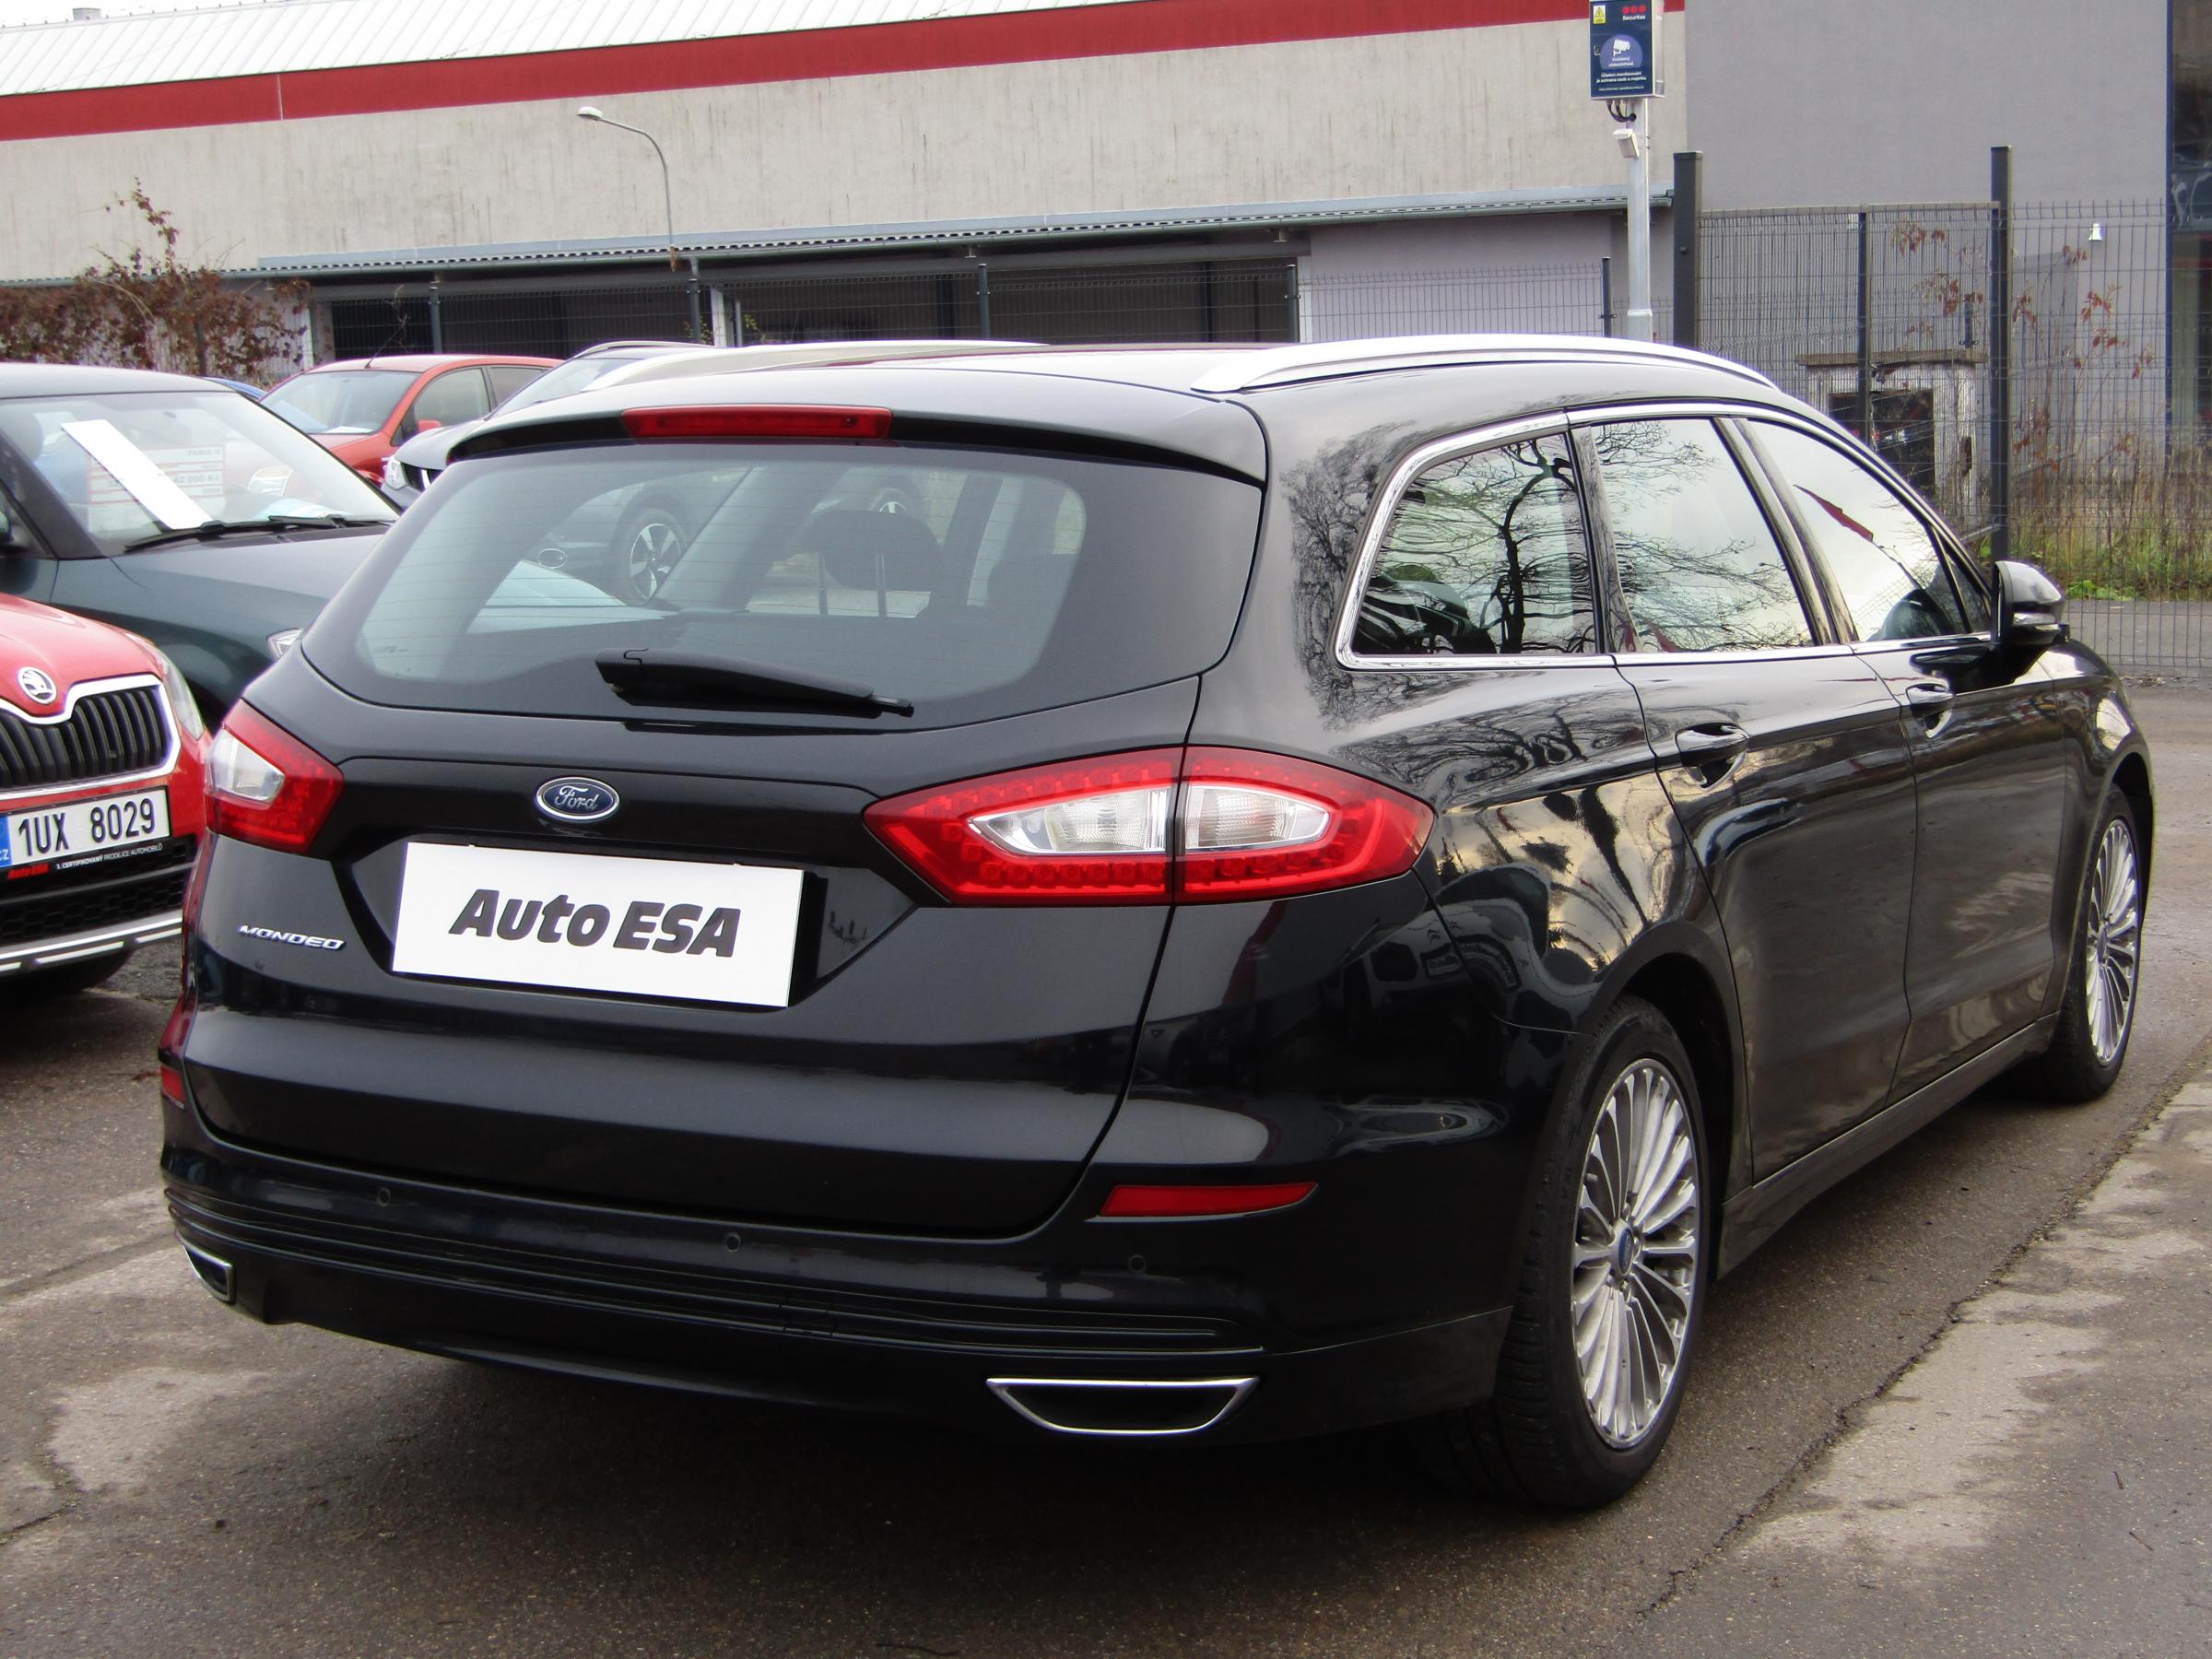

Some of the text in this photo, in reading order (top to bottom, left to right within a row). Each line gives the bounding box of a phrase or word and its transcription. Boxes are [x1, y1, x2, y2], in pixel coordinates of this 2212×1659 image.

[554, 784, 600, 810] Ford
[18, 797, 156, 857] 1UX 8029
[238, 924, 347, 951] MONDEO
[447, 888, 742, 959] Auto ESA
